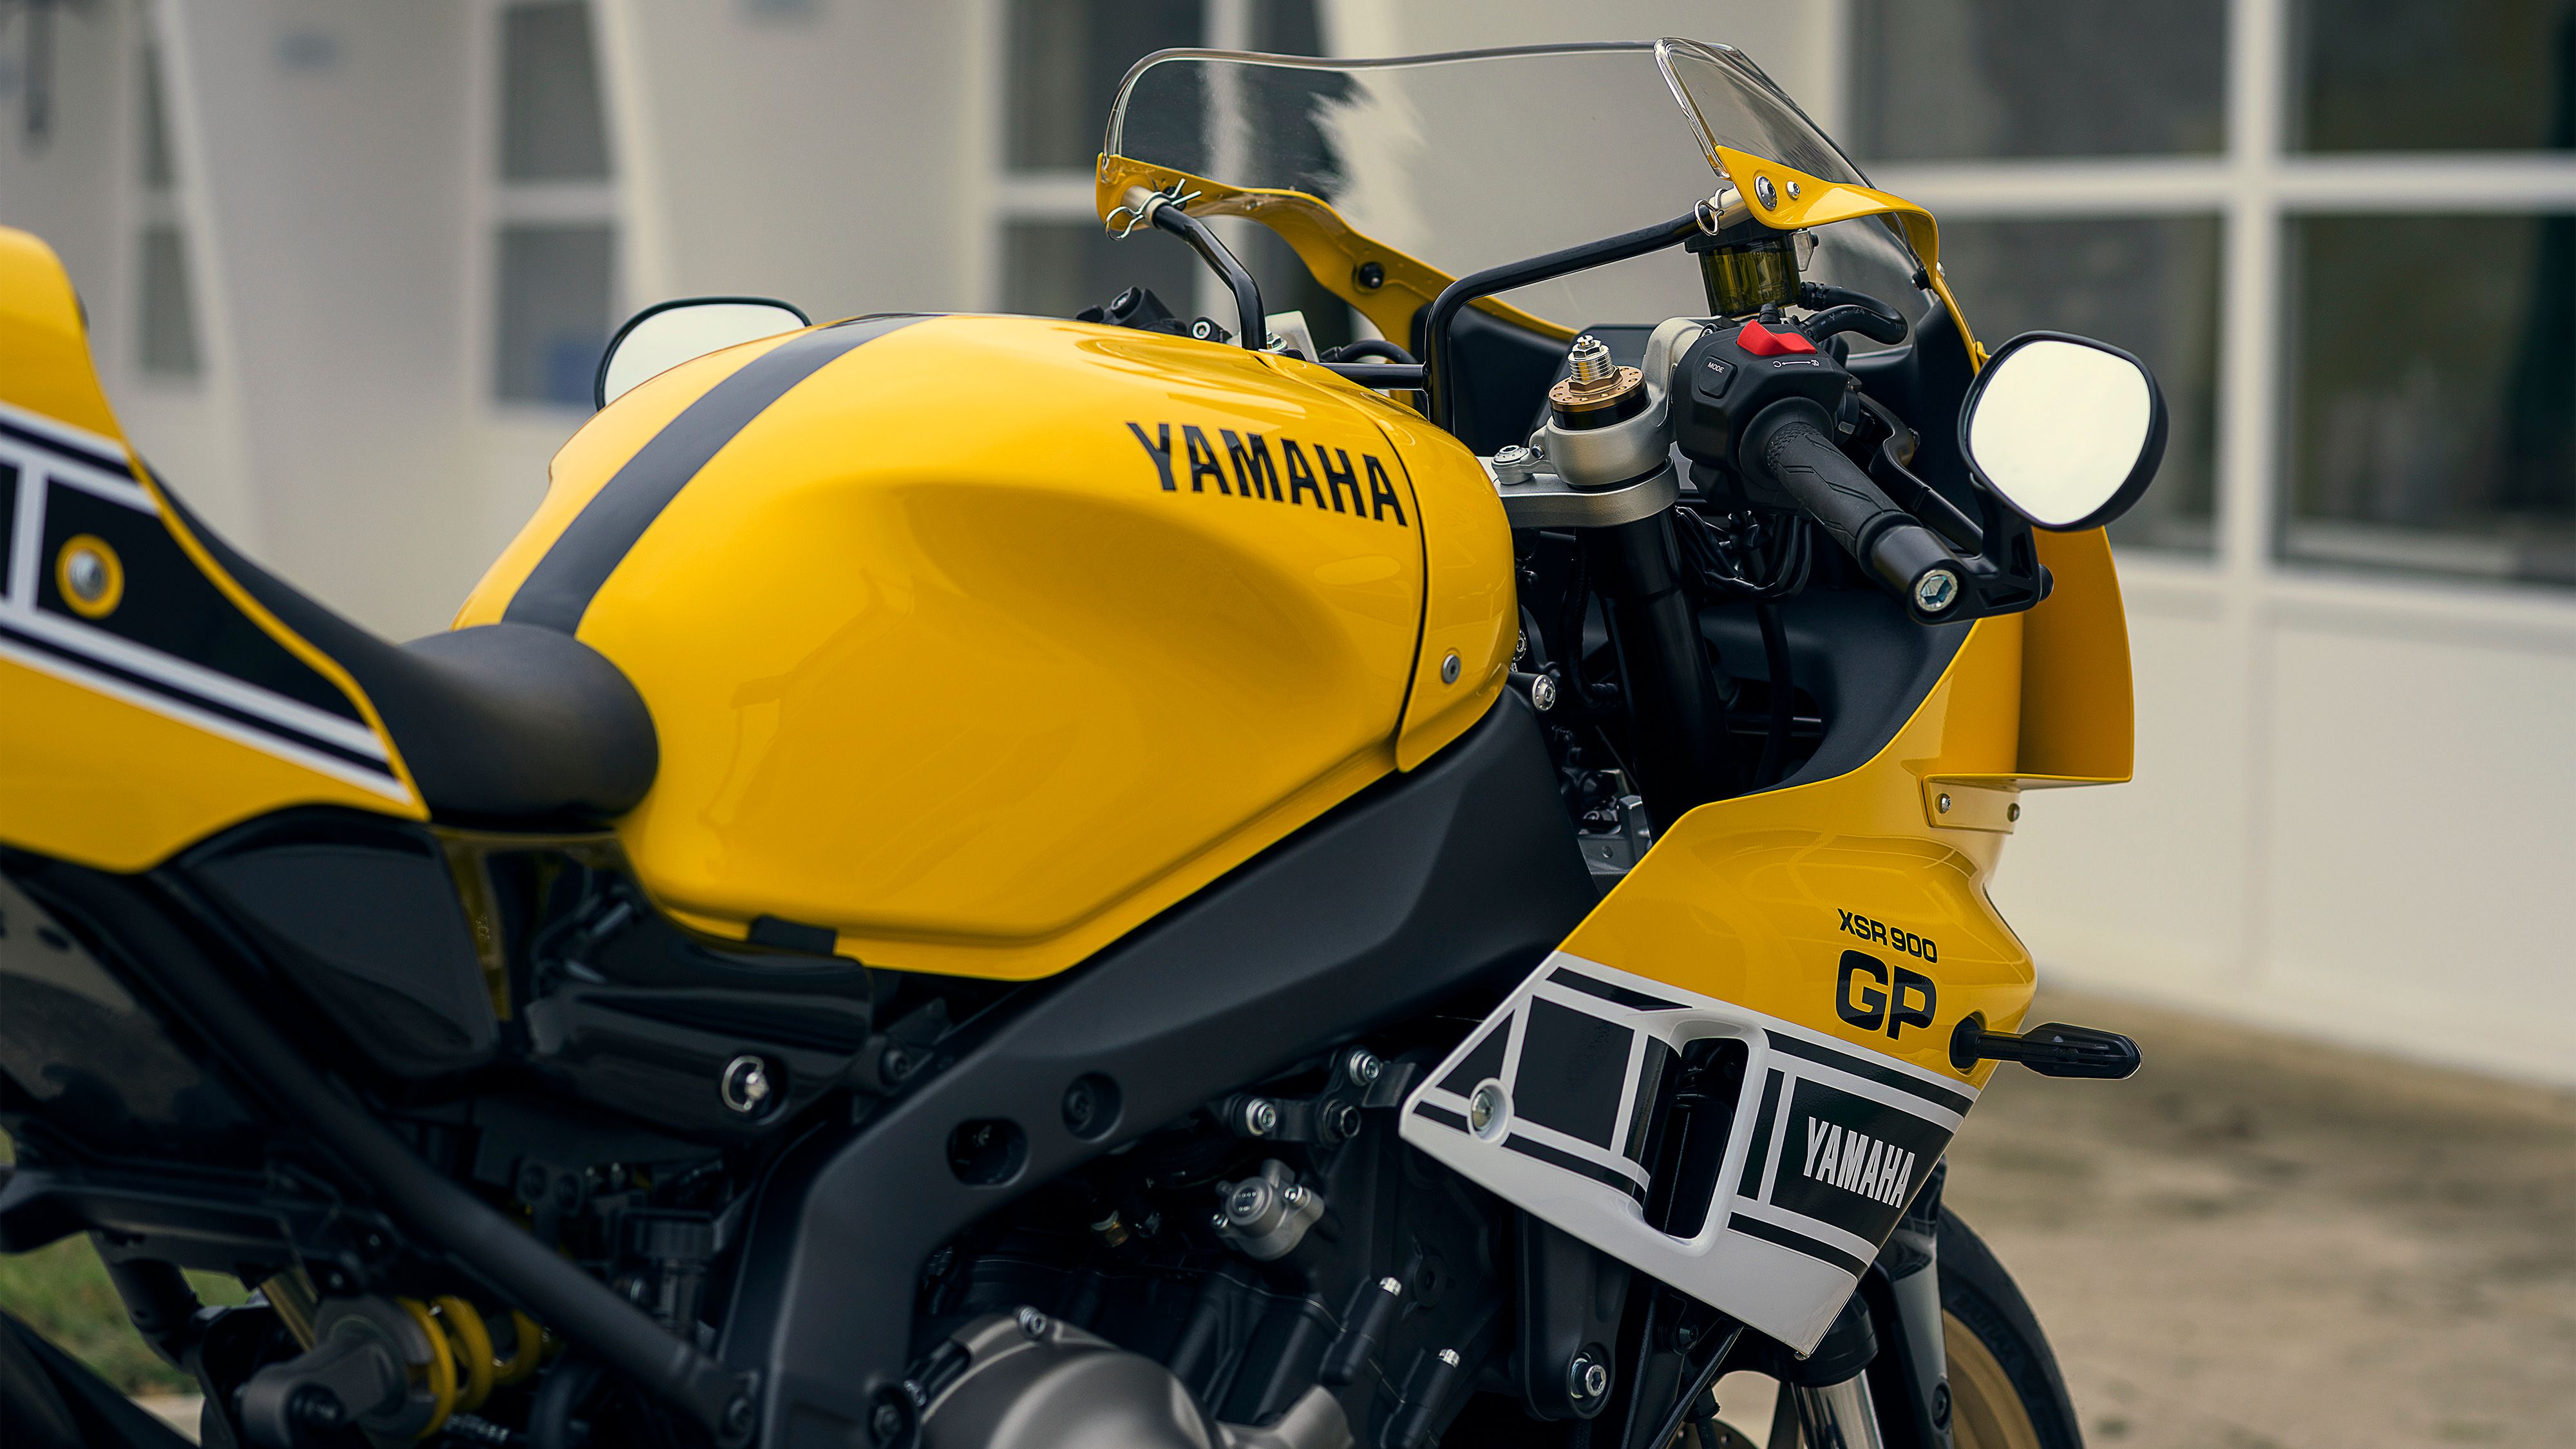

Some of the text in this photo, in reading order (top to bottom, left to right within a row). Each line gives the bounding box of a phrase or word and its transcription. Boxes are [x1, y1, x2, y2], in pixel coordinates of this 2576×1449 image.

[1707, 361, 1725, 374] MODE
[1126, 421, 1408, 527] YAMAHA
[1837, 908, 1938, 963] XSR 900
[1835, 949, 1937, 1041] GP
[1803, 1116, 1915, 1208] YAMAHA
